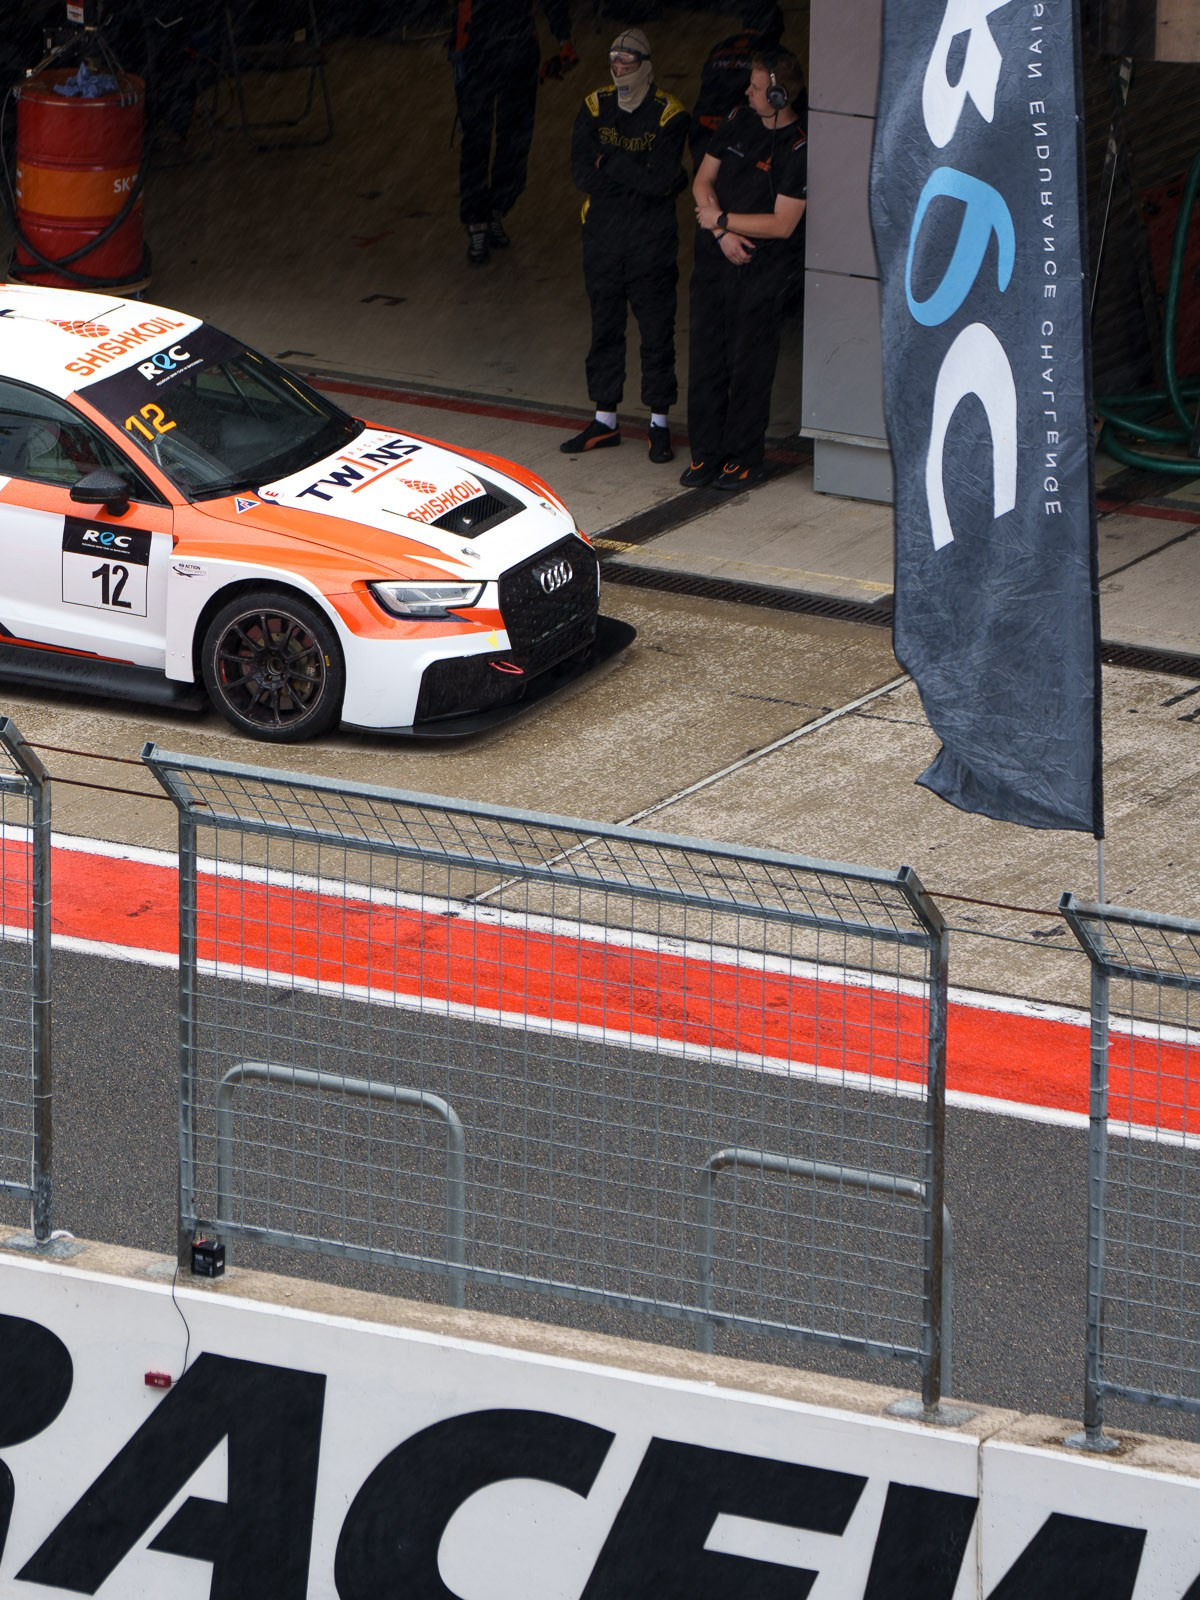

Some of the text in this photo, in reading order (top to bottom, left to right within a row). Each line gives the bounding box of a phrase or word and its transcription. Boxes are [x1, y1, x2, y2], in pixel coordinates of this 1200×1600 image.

[64, 317, 186, 377] SHISHKOIL
[125, 403, 177, 441] 12
[295, 439, 423, 501] TWINS
[407, 480, 481, 525] SHISHKOIL
[92, 563, 132, 609] 12
